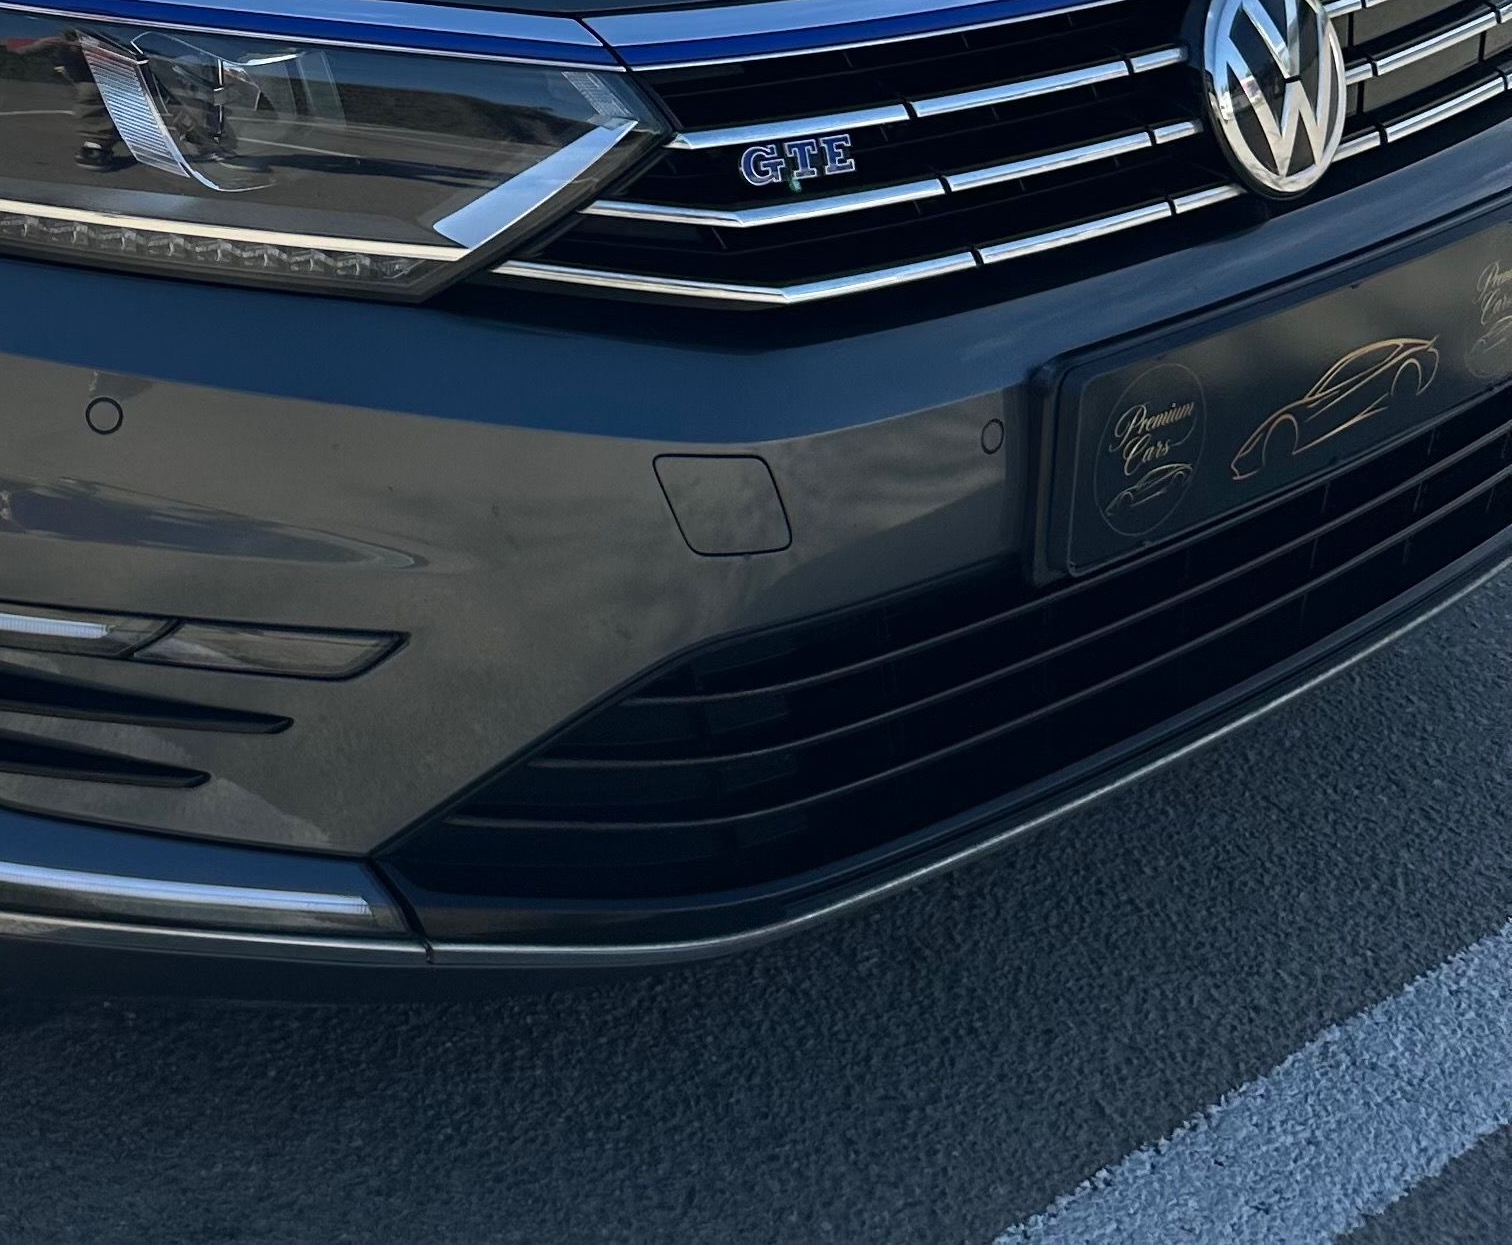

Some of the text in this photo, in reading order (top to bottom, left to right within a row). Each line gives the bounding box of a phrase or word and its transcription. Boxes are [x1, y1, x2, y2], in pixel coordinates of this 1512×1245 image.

[740, 133, 856, 186] GTE
[1108, 402, 1195, 453] Premium
[1123, 434, 1172, 476] Cars
